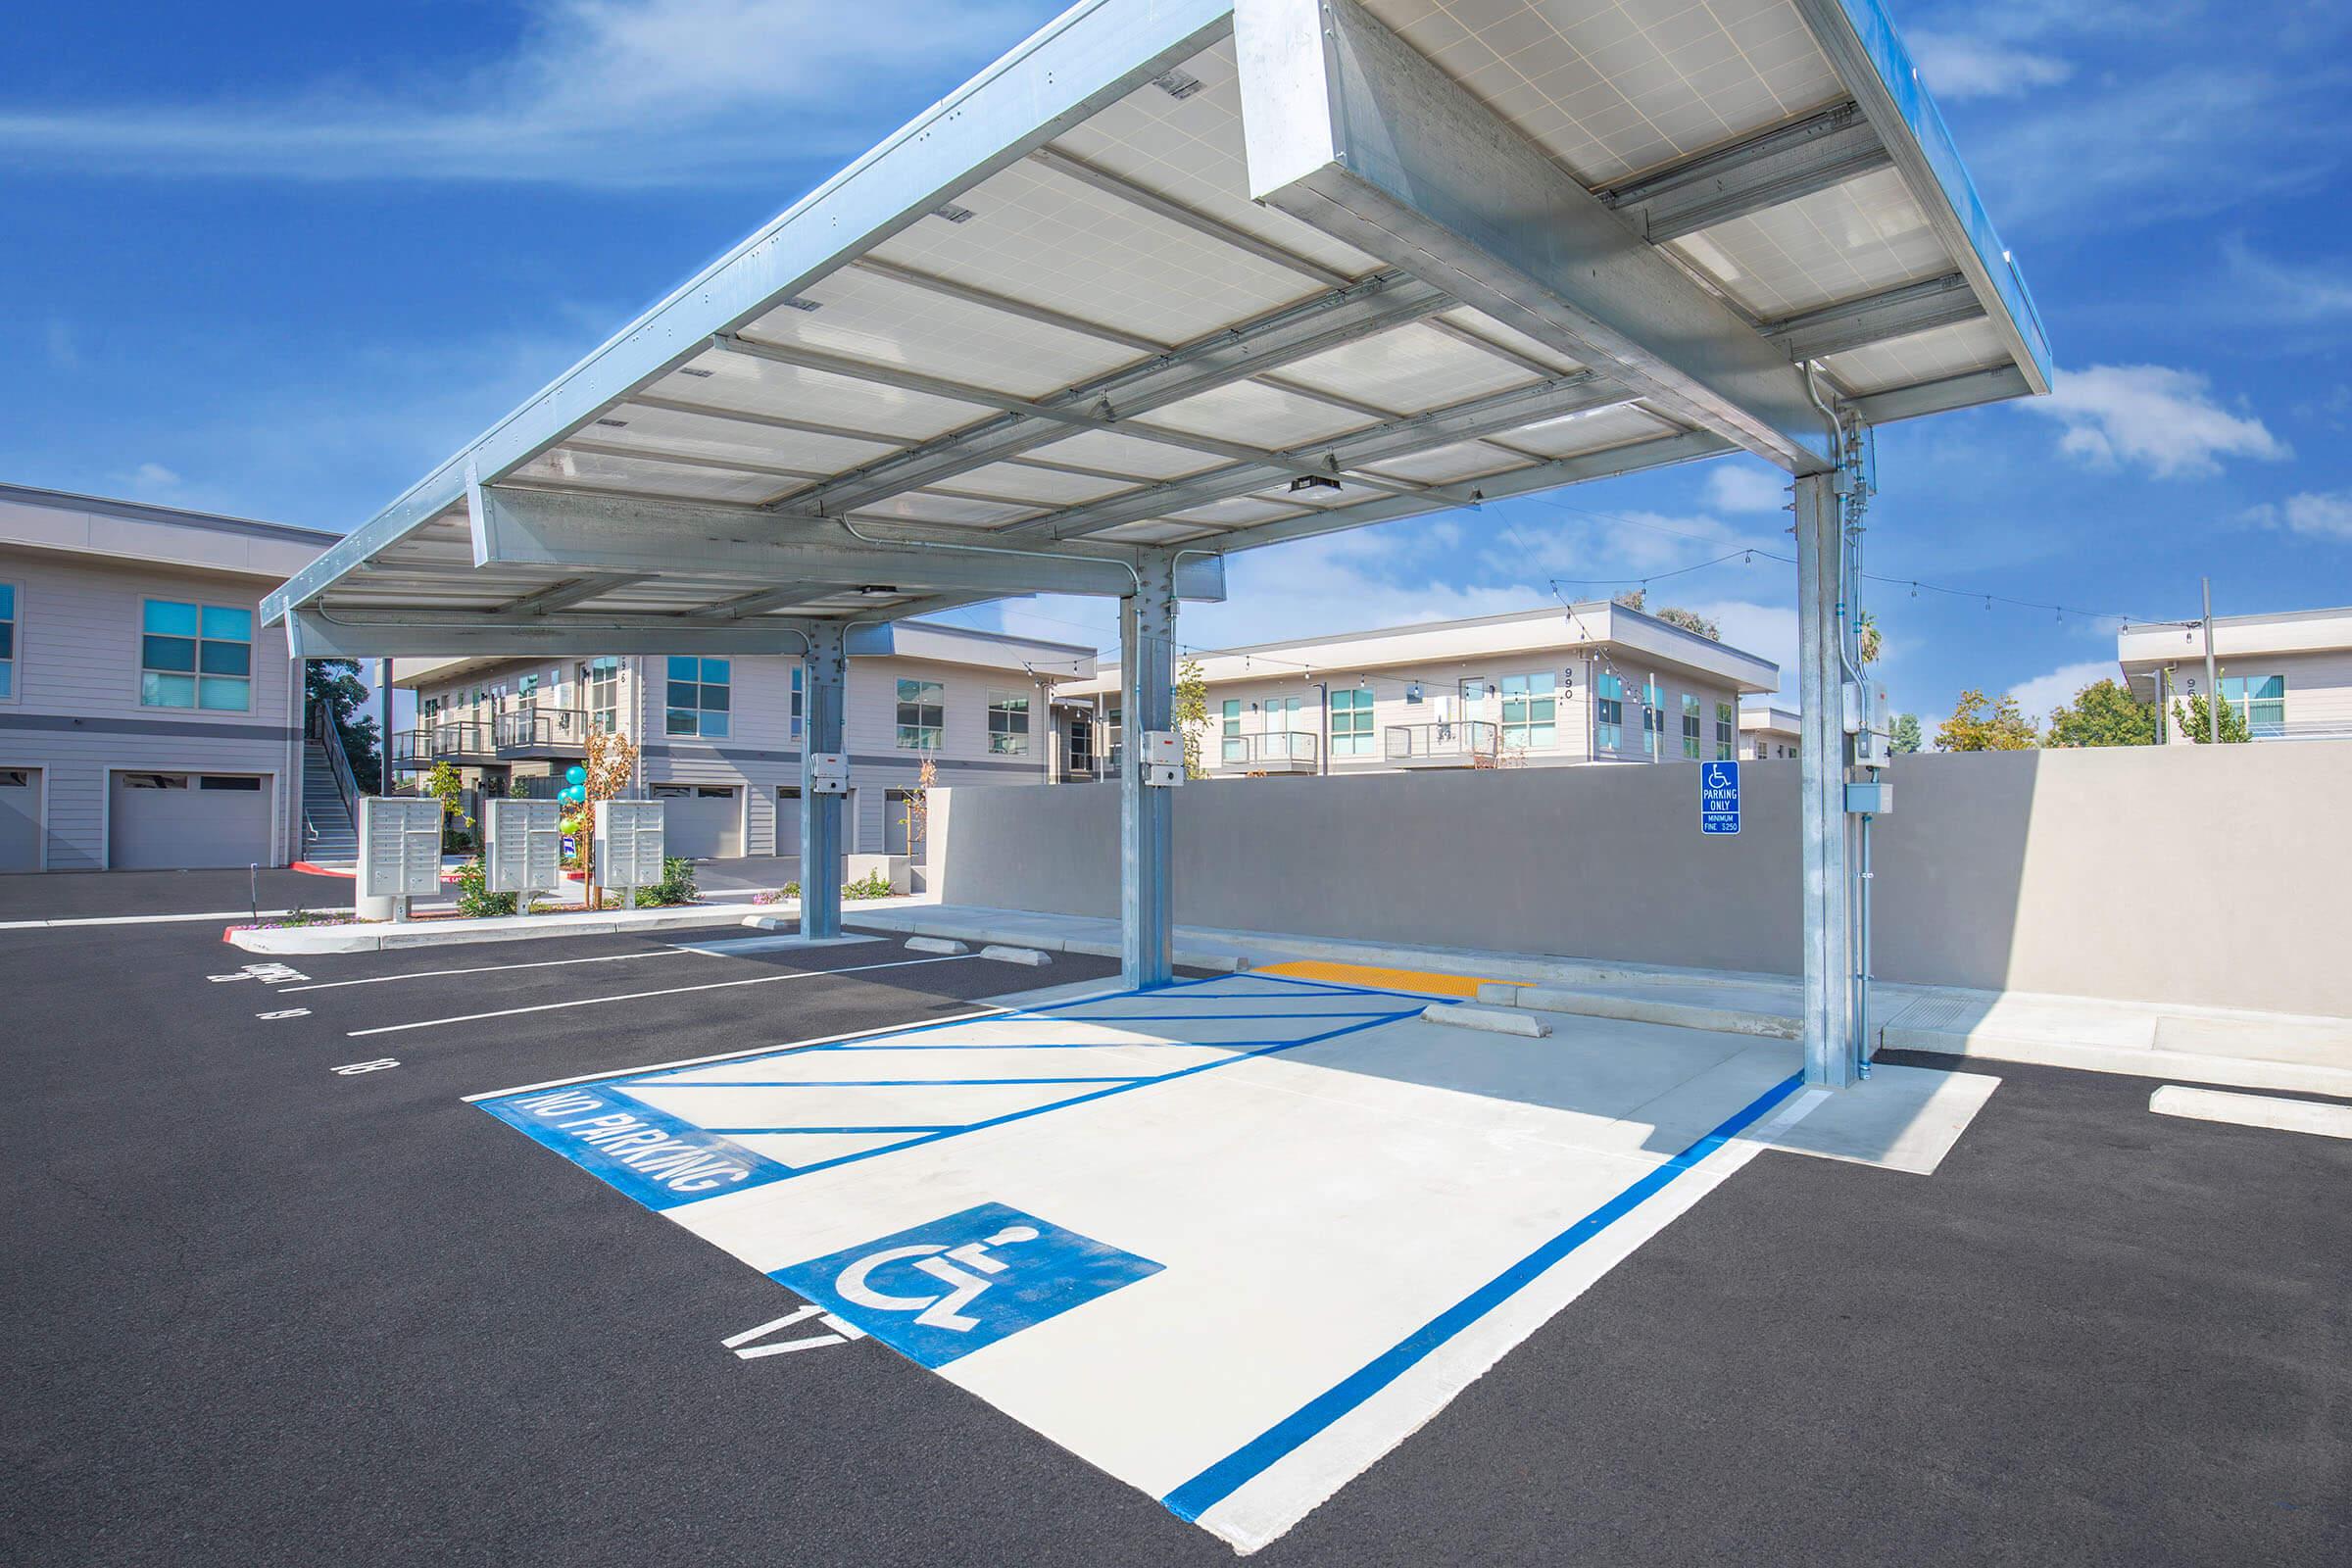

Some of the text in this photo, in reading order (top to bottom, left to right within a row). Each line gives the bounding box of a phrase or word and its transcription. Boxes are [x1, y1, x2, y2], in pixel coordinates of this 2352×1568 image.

[1703, 789, 1738, 800] PARKING
[1710, 800, 1731, 810] ONLY
[514, 1090, 749, 1193] NO PARKING
